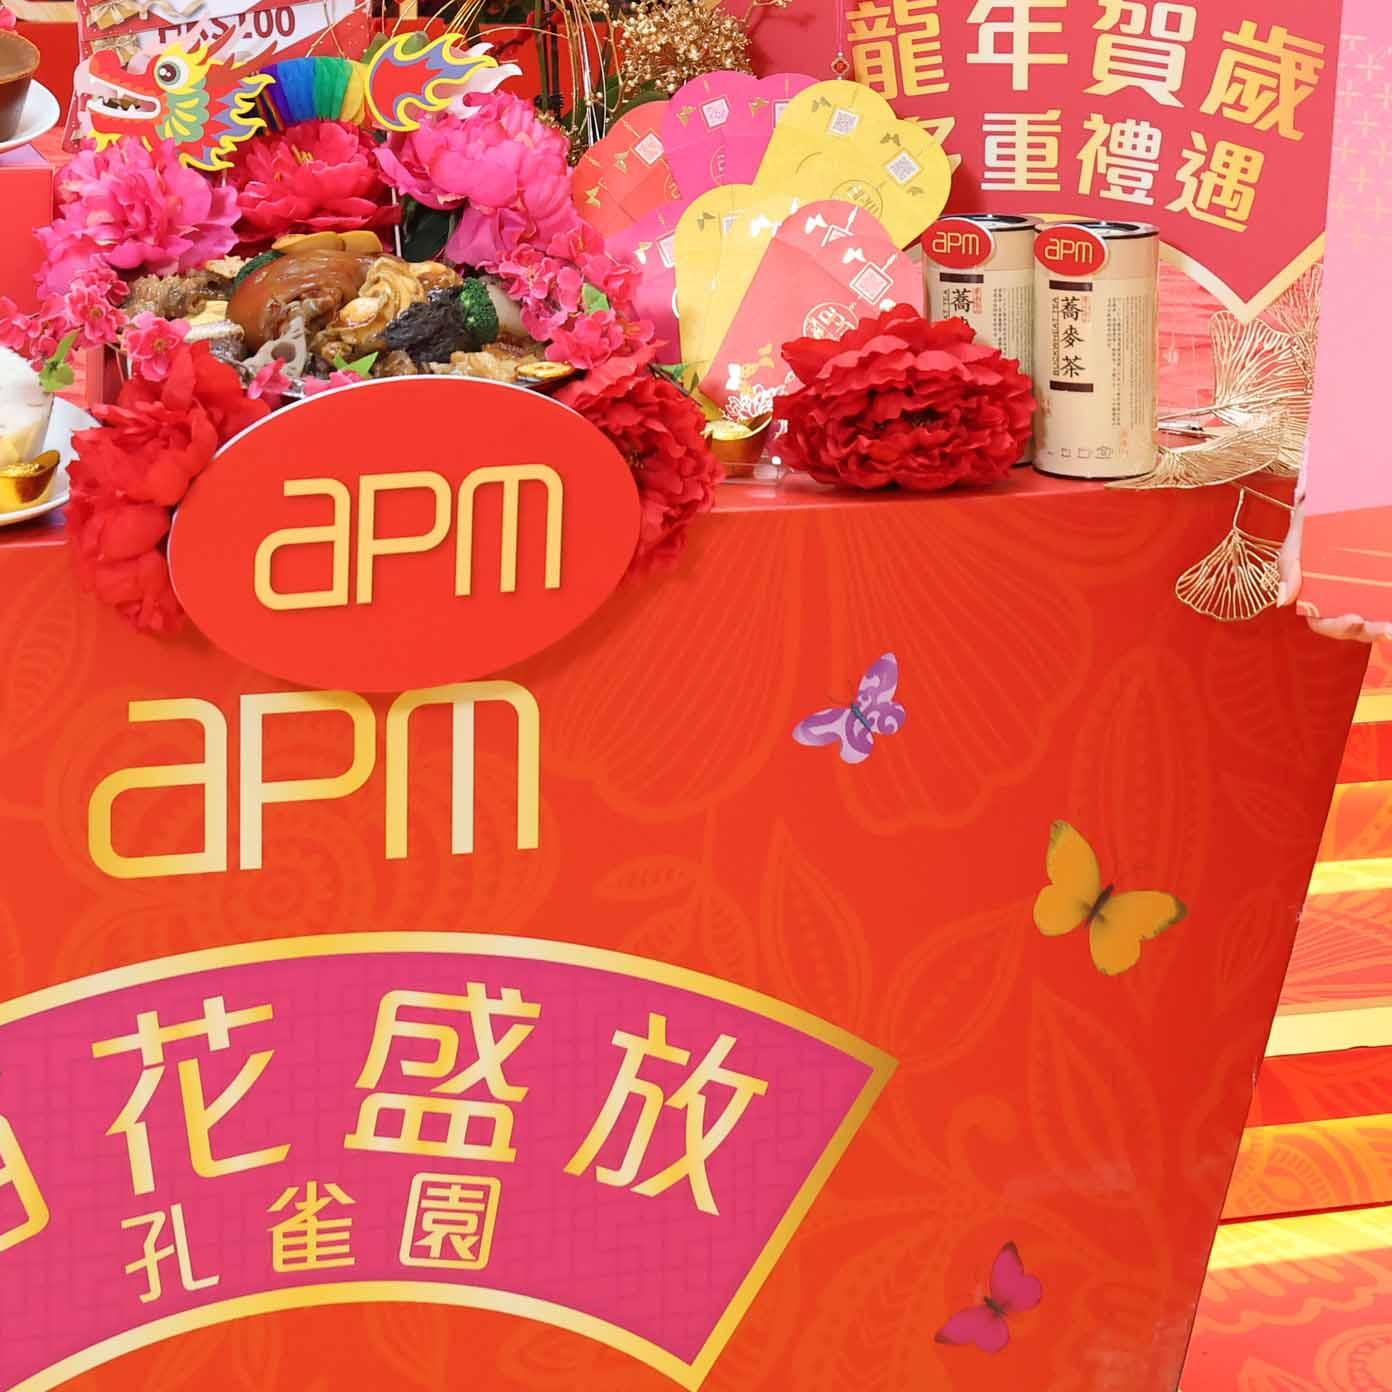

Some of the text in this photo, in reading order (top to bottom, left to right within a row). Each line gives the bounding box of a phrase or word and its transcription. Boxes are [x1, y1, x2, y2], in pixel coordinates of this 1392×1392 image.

[1059, 296, 1086, 378] 蕎麥茶
[121, 1172, 504, 1305] 孔雀園
